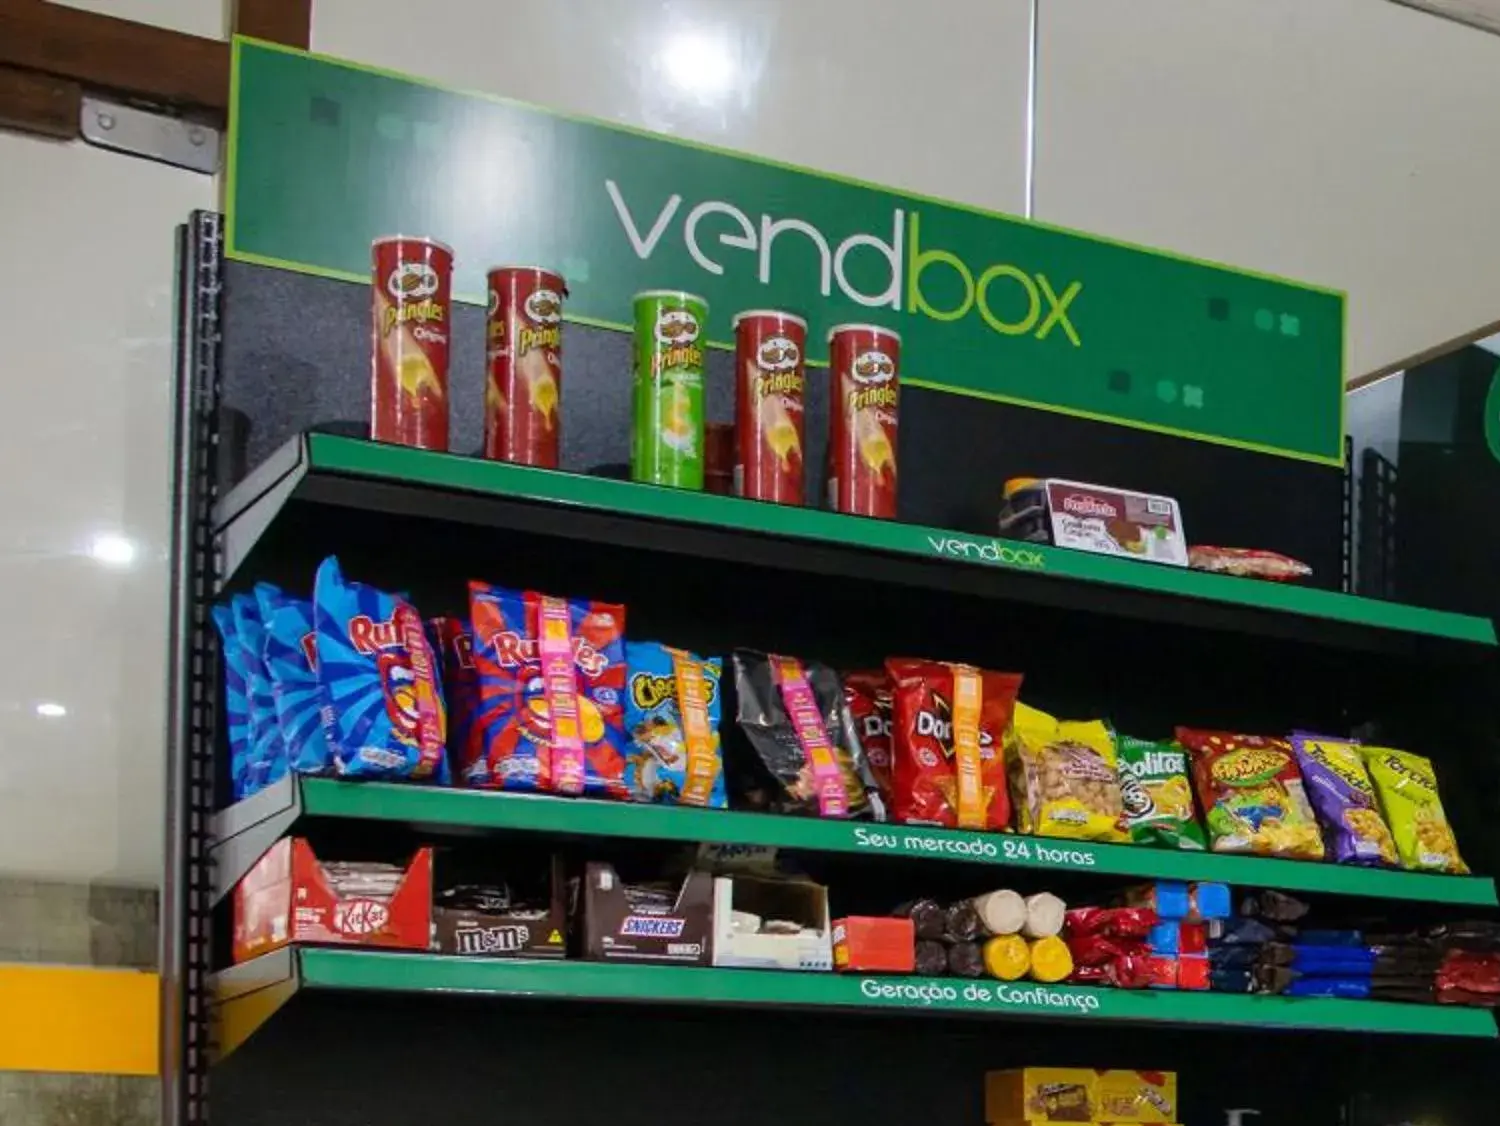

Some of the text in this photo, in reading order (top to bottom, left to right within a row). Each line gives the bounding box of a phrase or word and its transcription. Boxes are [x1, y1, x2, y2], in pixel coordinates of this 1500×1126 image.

[605, 179, 1082, 348] vendbox
[383, 299, 443, 340] Pringles
[928, 535, 1046, 567] vendbox
[853, 828, 1096, 867] Seu mercado 24 horas
[622, 918, 683, 935] SNICKERS
[861, 979, 1100, 1013] Geração de Confiança
